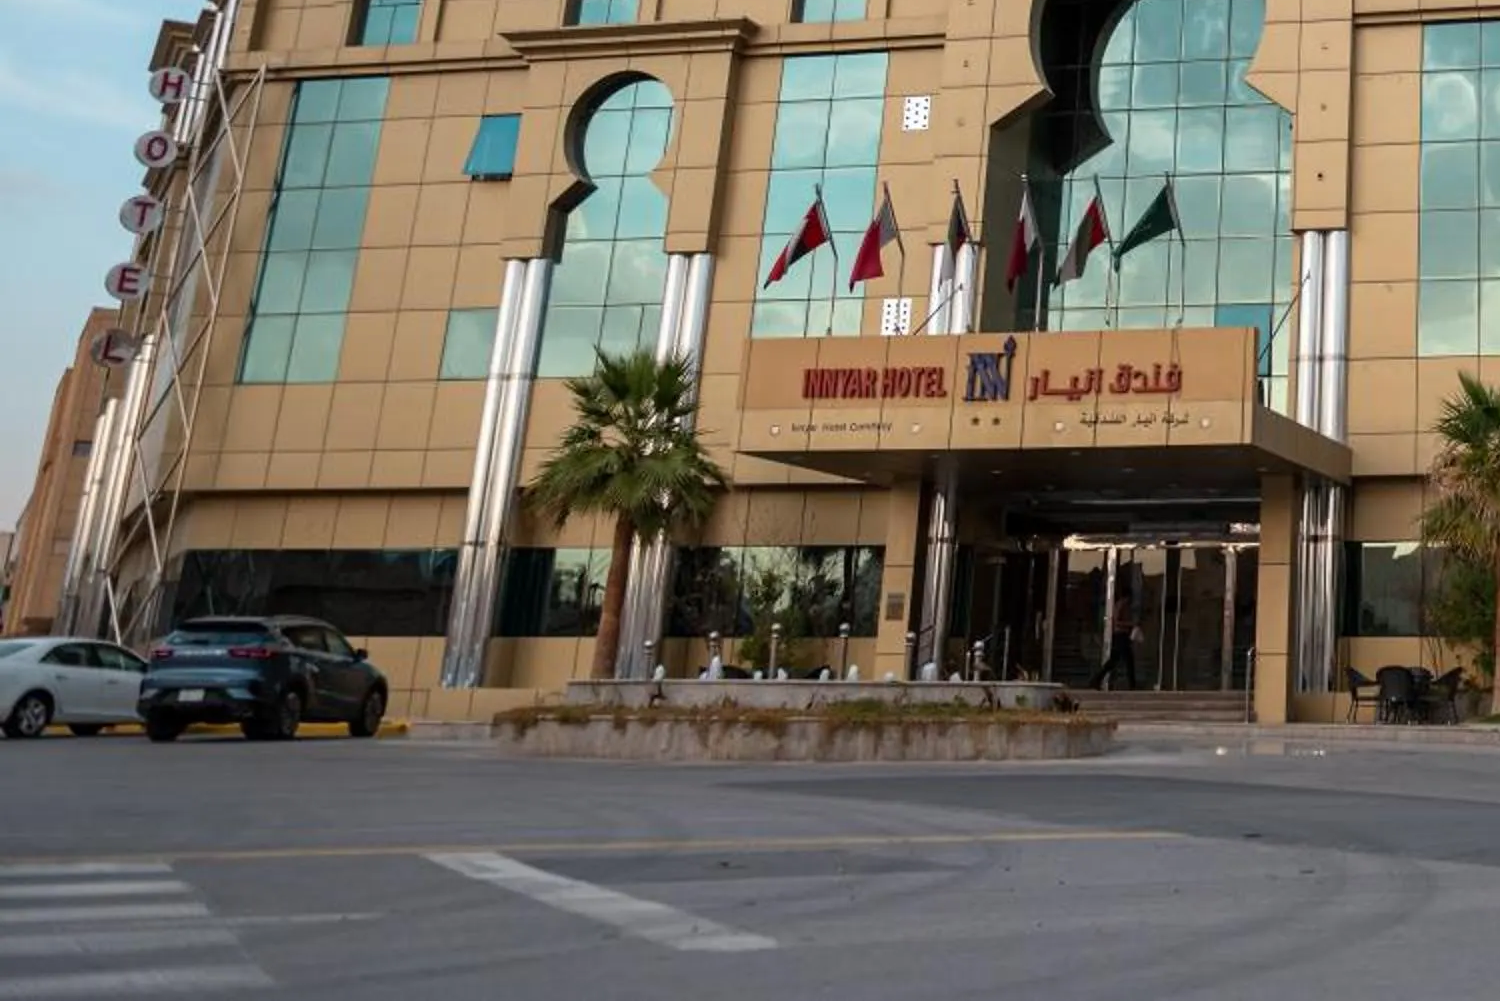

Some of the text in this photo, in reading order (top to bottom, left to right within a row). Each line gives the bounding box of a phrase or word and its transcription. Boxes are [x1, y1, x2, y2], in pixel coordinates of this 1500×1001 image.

[101, 71, 184, 363] HOTEL
[802, 366, 948, 399] INNYAR HOTEL
[1109, 363, 1183, 394] فندق
